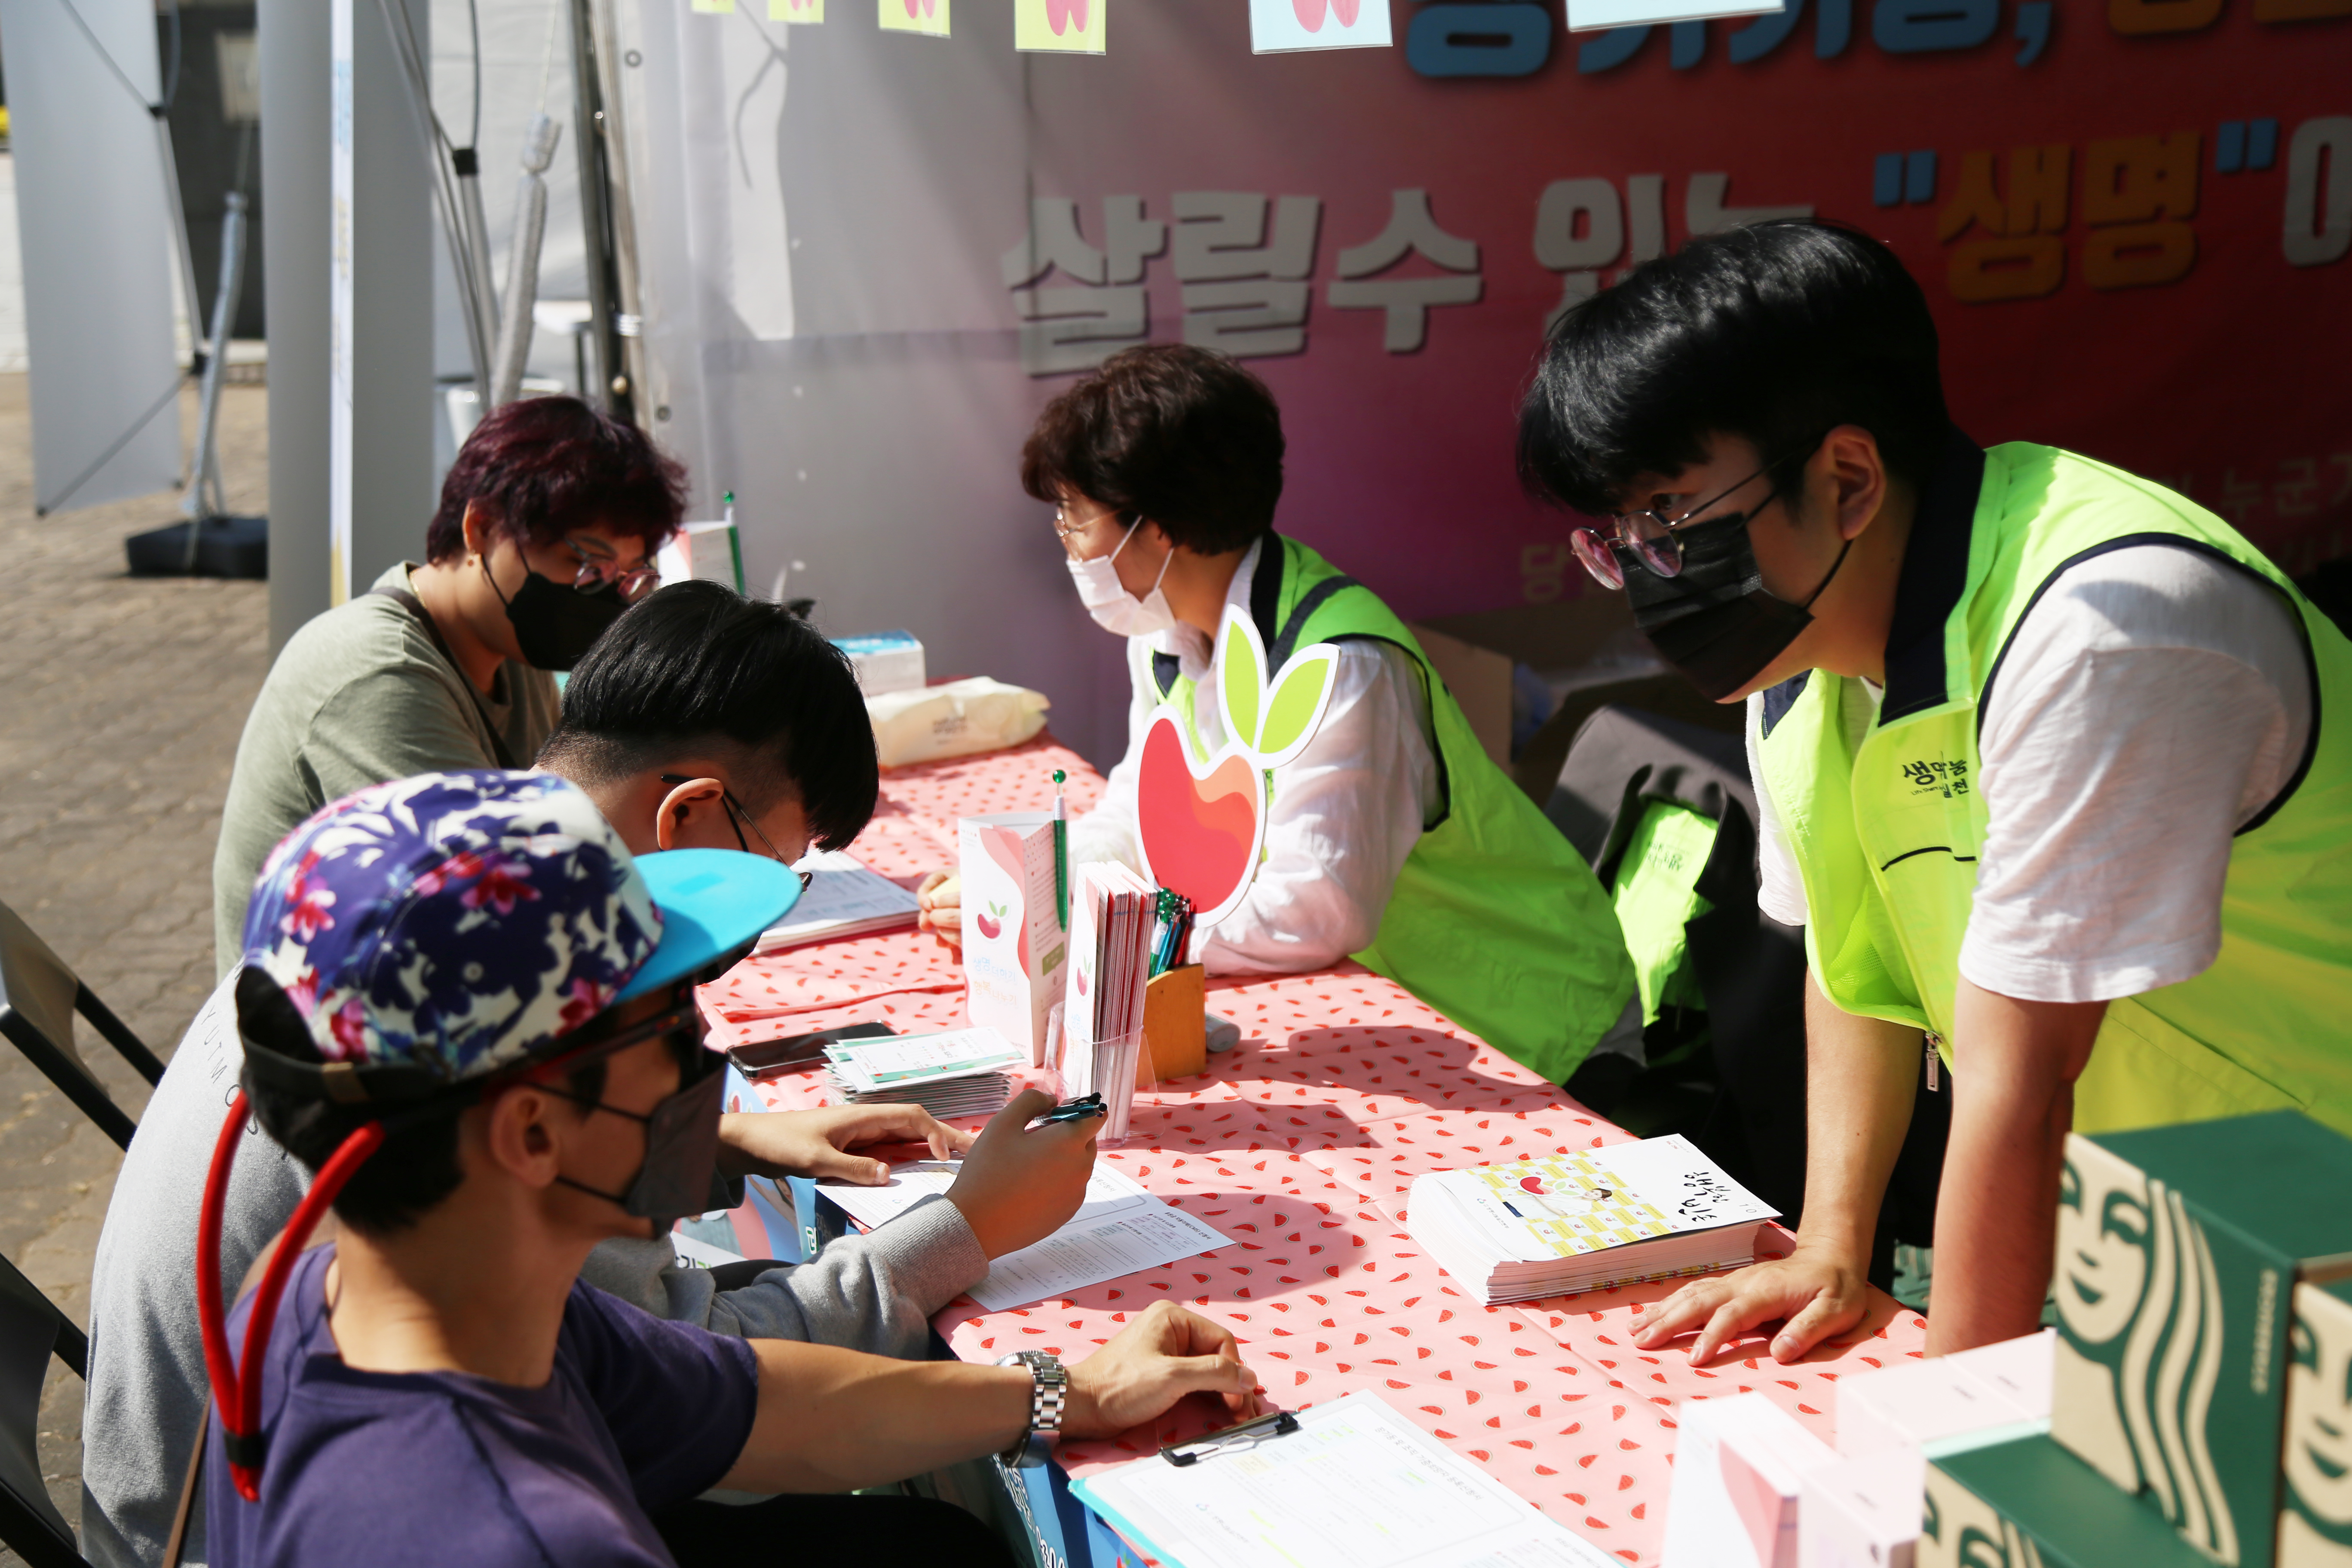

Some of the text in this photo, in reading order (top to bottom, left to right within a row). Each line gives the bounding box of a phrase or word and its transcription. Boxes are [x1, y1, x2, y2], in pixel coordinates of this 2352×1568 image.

[973, 957, 1016, 982] 생명 더하기
[974, 980, 1017, 1005] 행복 나누기
[1684, 1172, 1731, 1204] 행복한
[1678, 1198, 1718, 1222] 빈손
